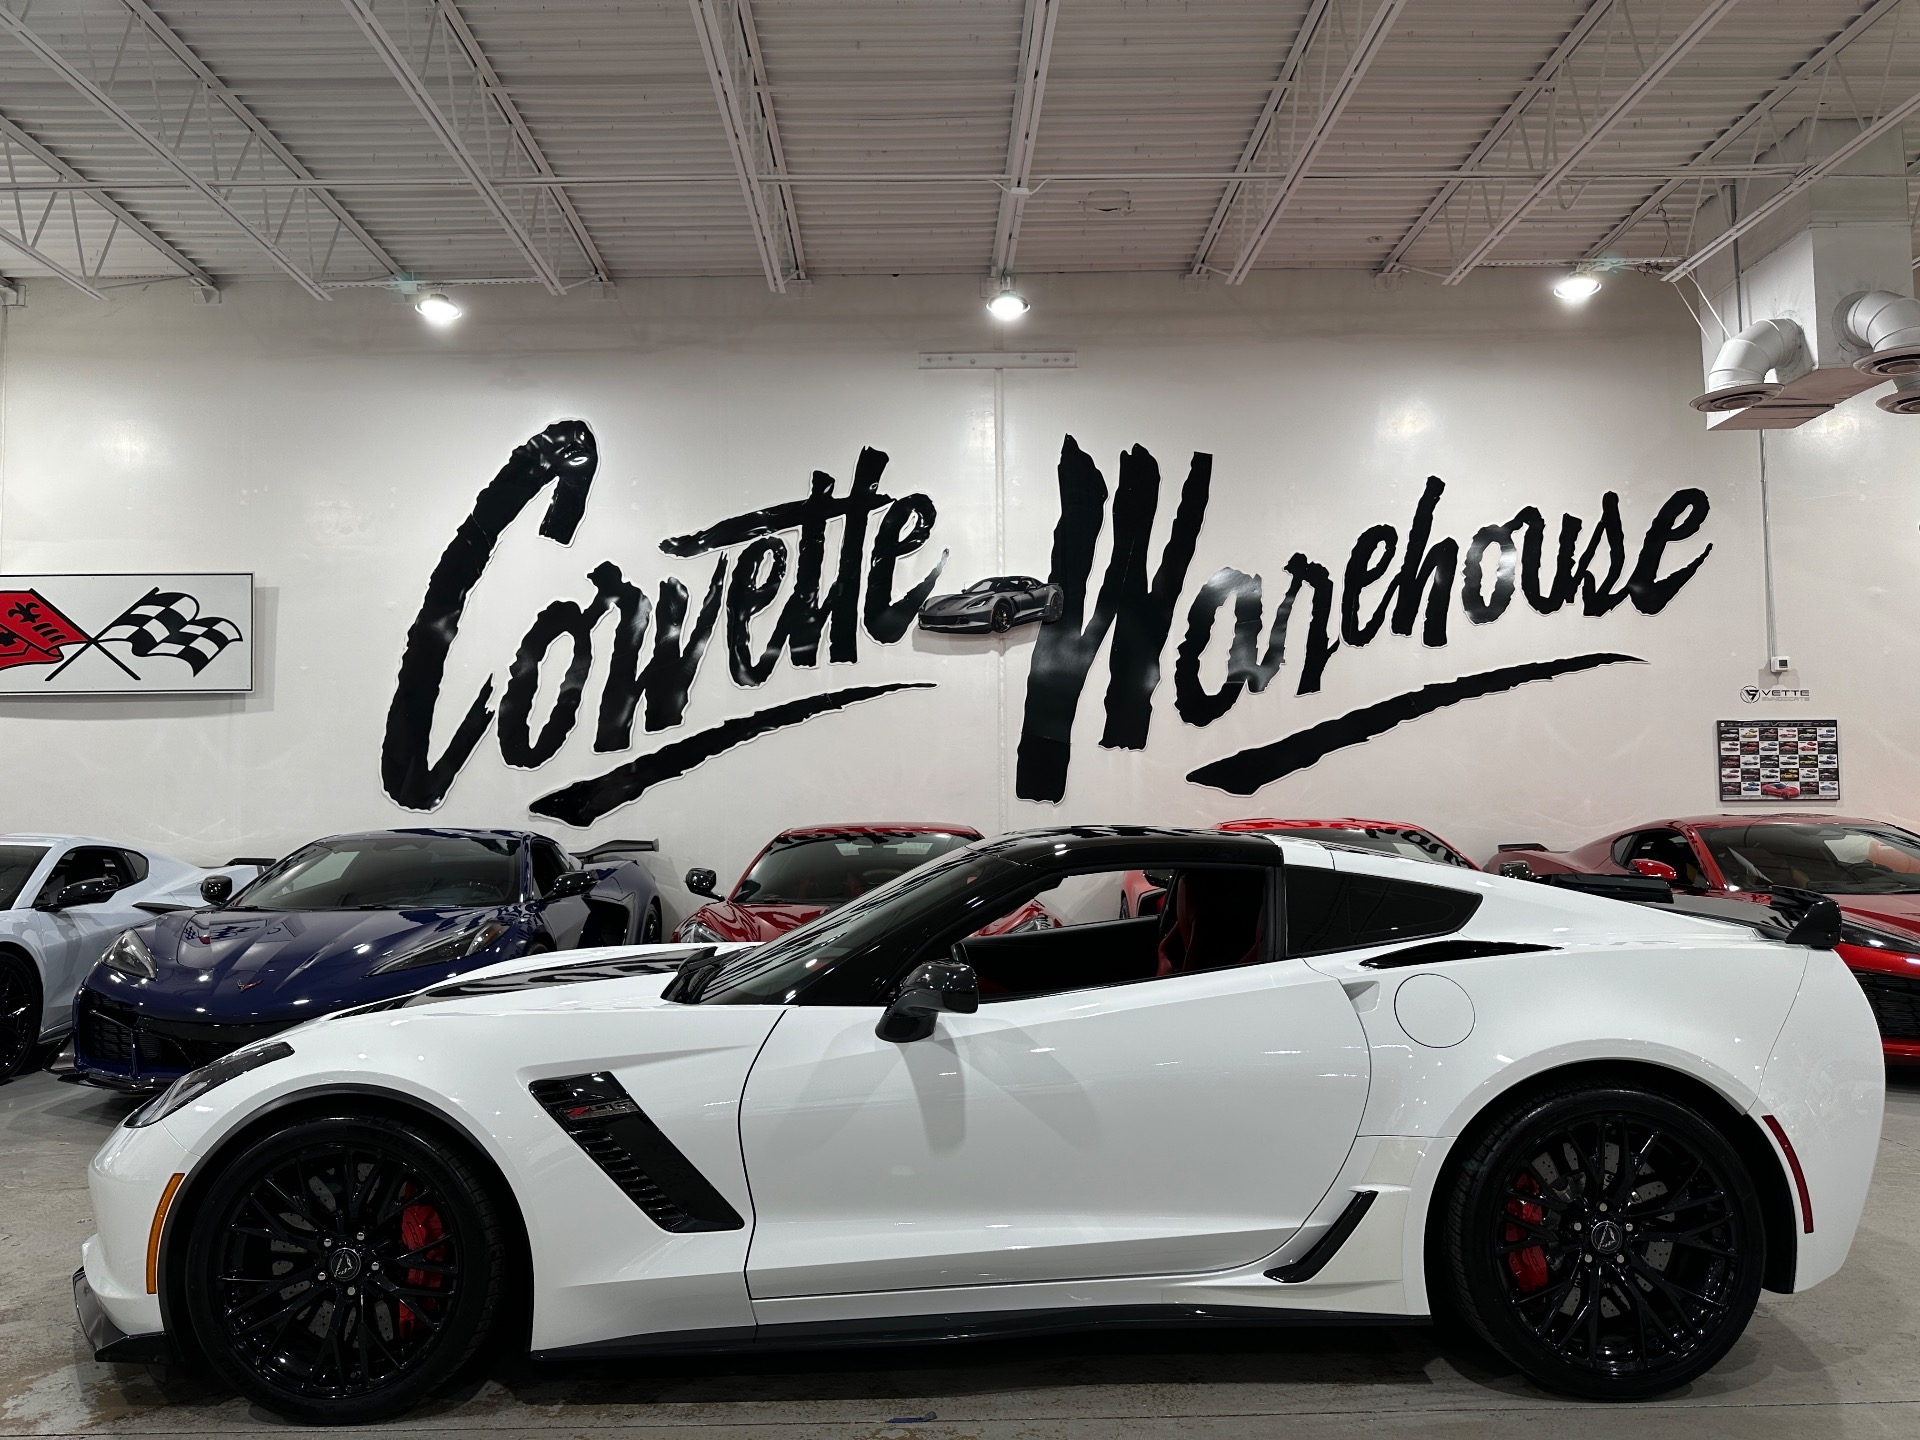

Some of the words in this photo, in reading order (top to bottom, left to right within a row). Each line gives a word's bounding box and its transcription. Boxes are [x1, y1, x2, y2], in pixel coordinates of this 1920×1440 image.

[380, 419, 950, 812] Corvette
[1015, 433, 1713, 804] Warehouse
[1761, 689, 1810, 697] VETTE
